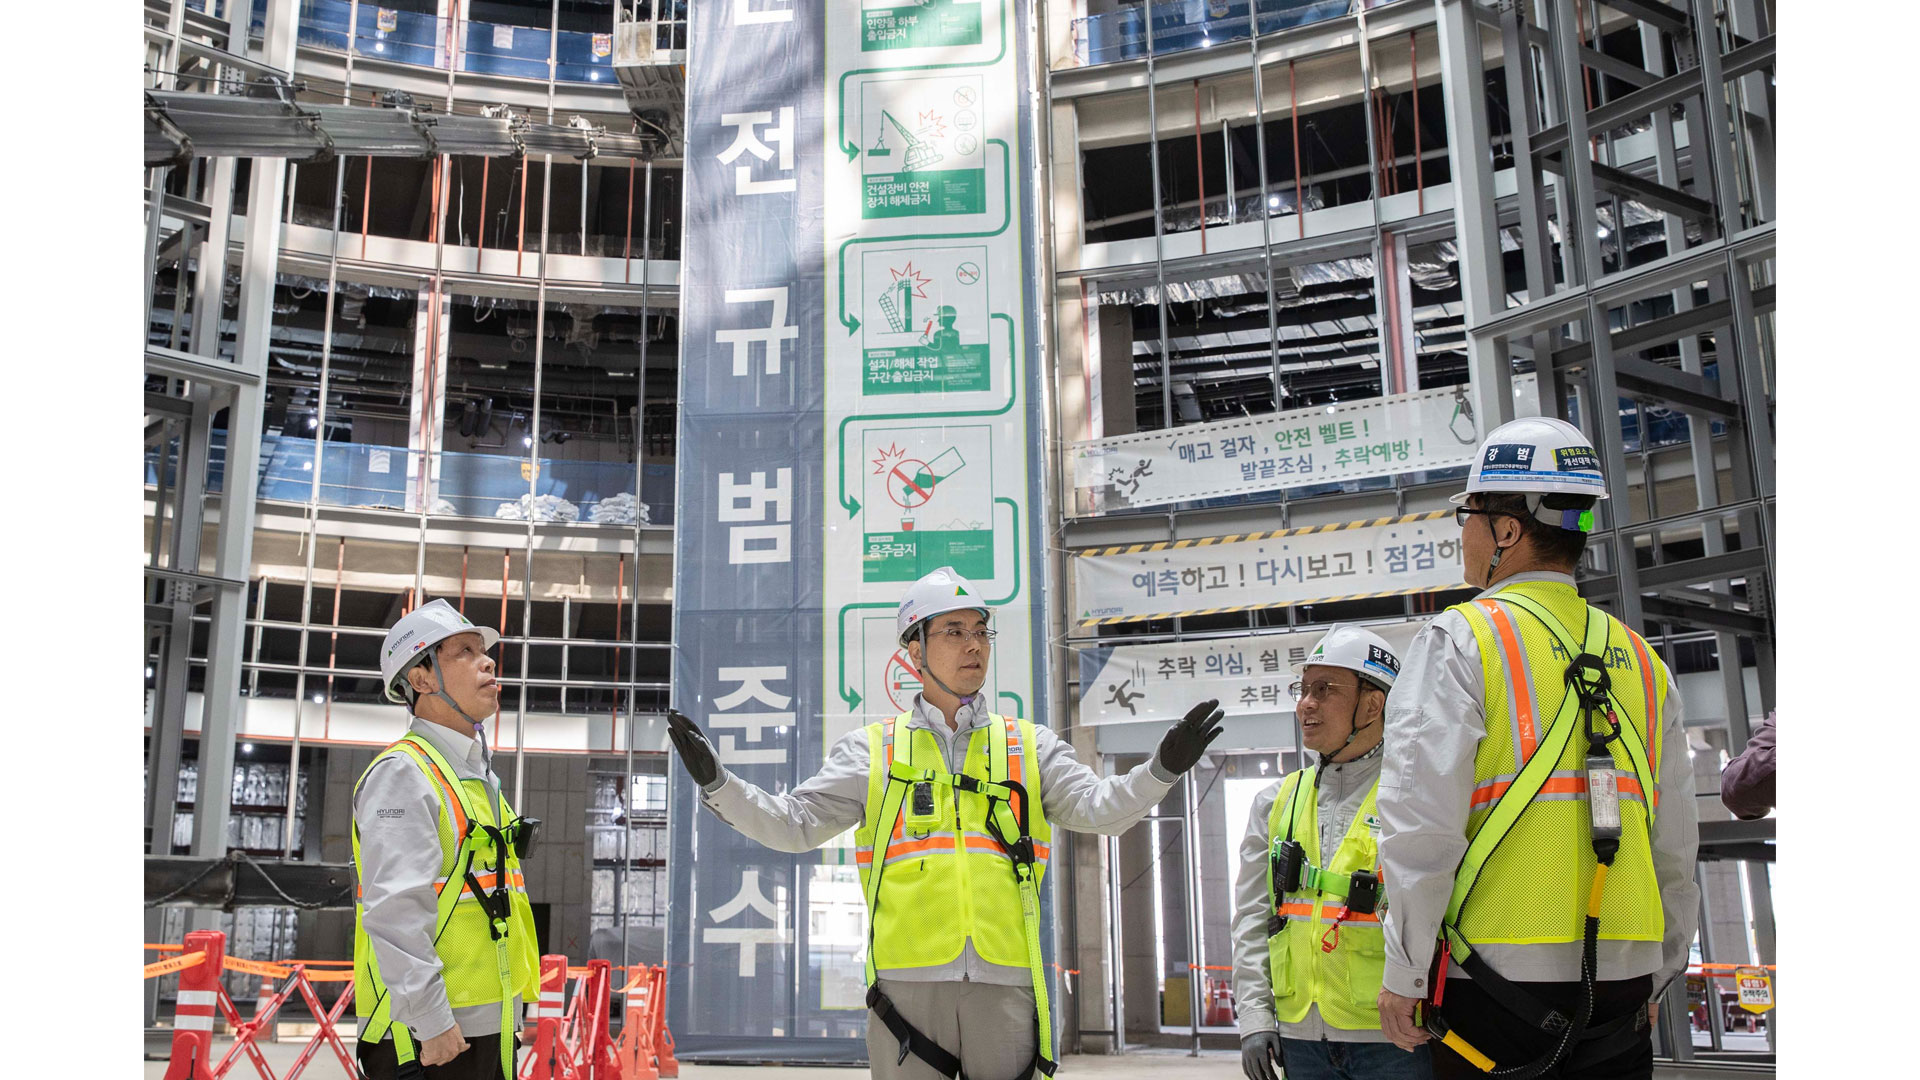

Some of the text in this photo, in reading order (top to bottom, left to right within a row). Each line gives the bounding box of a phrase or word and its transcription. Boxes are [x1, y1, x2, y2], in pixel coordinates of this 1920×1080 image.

[867, 28, 906, 41] 출입금지
[867, 181, 930, 196] 건설장비 안전
[867, 194, 931, 208] 장치 해체금지
[868, 356, 938, 371] 설치/해체 작업
[868, 371, 891, 384] 구간
[892, 370, 934, 383] 출입금지
[1178, 442, 1214, 464] 매고
[1275, 426, 1312, 450] 안전
[868, 543, 916, 558] 음주금지
[1384, 538, 1463, 574] 점검하
[391, 630, 415, 650] HYUNDAI
[1157, 656, 1197, 680] 추락
[1259, 649, 1279, 672] 쉴
[1240, 684, 1281, 707] 추락
